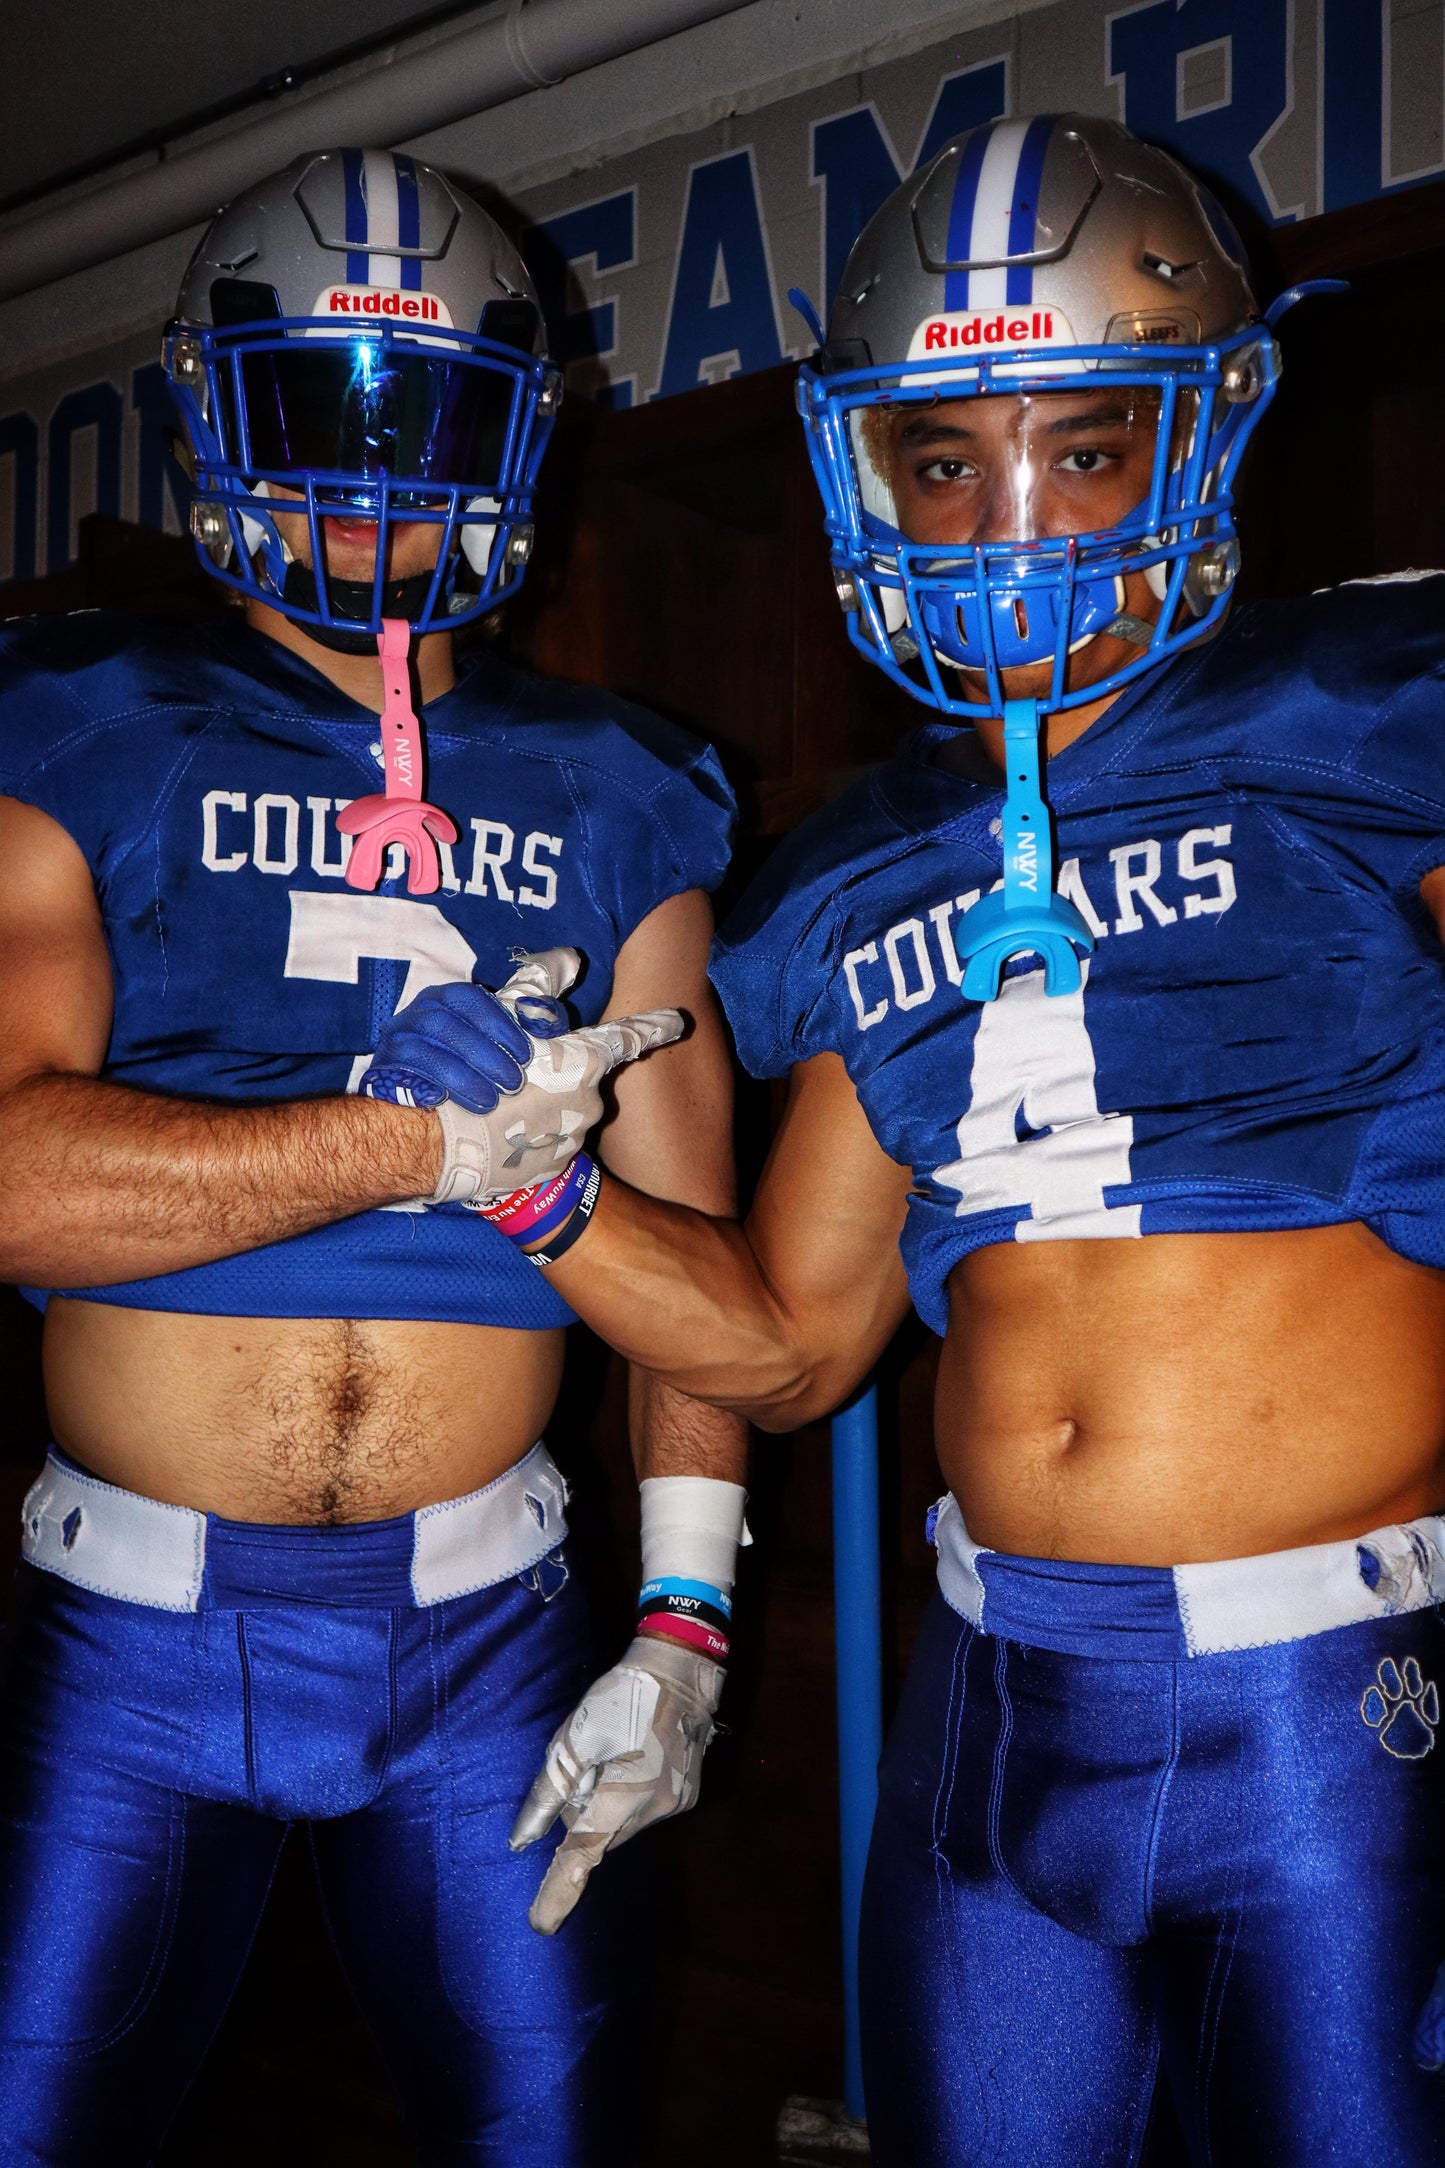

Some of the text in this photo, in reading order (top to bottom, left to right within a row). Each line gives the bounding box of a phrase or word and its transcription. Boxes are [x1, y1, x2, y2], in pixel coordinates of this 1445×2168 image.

[328, 290, 439, 320] Riddell
[925, 312, 1053, 351] Riddell
[394, 737, 413, 788] NWY
[201, 789, 564, 910] COURS
[1016, 831, 1038, 893] NWY
[842, 824, 1238, 1032] COUARS
[575, 1173, 587, 1189] CSA
[514, 1185, 535, 1208] The
[533, 1175, 566, 1216] NuWay
[499, 1204, 517, 1222] Nu
[527, 1252, 553, 1267] VO
[667, 1595, 702, 1610] NWY
[676, 1605, 693, 1614] Gear
[706, 1635, 721, 1650] The
